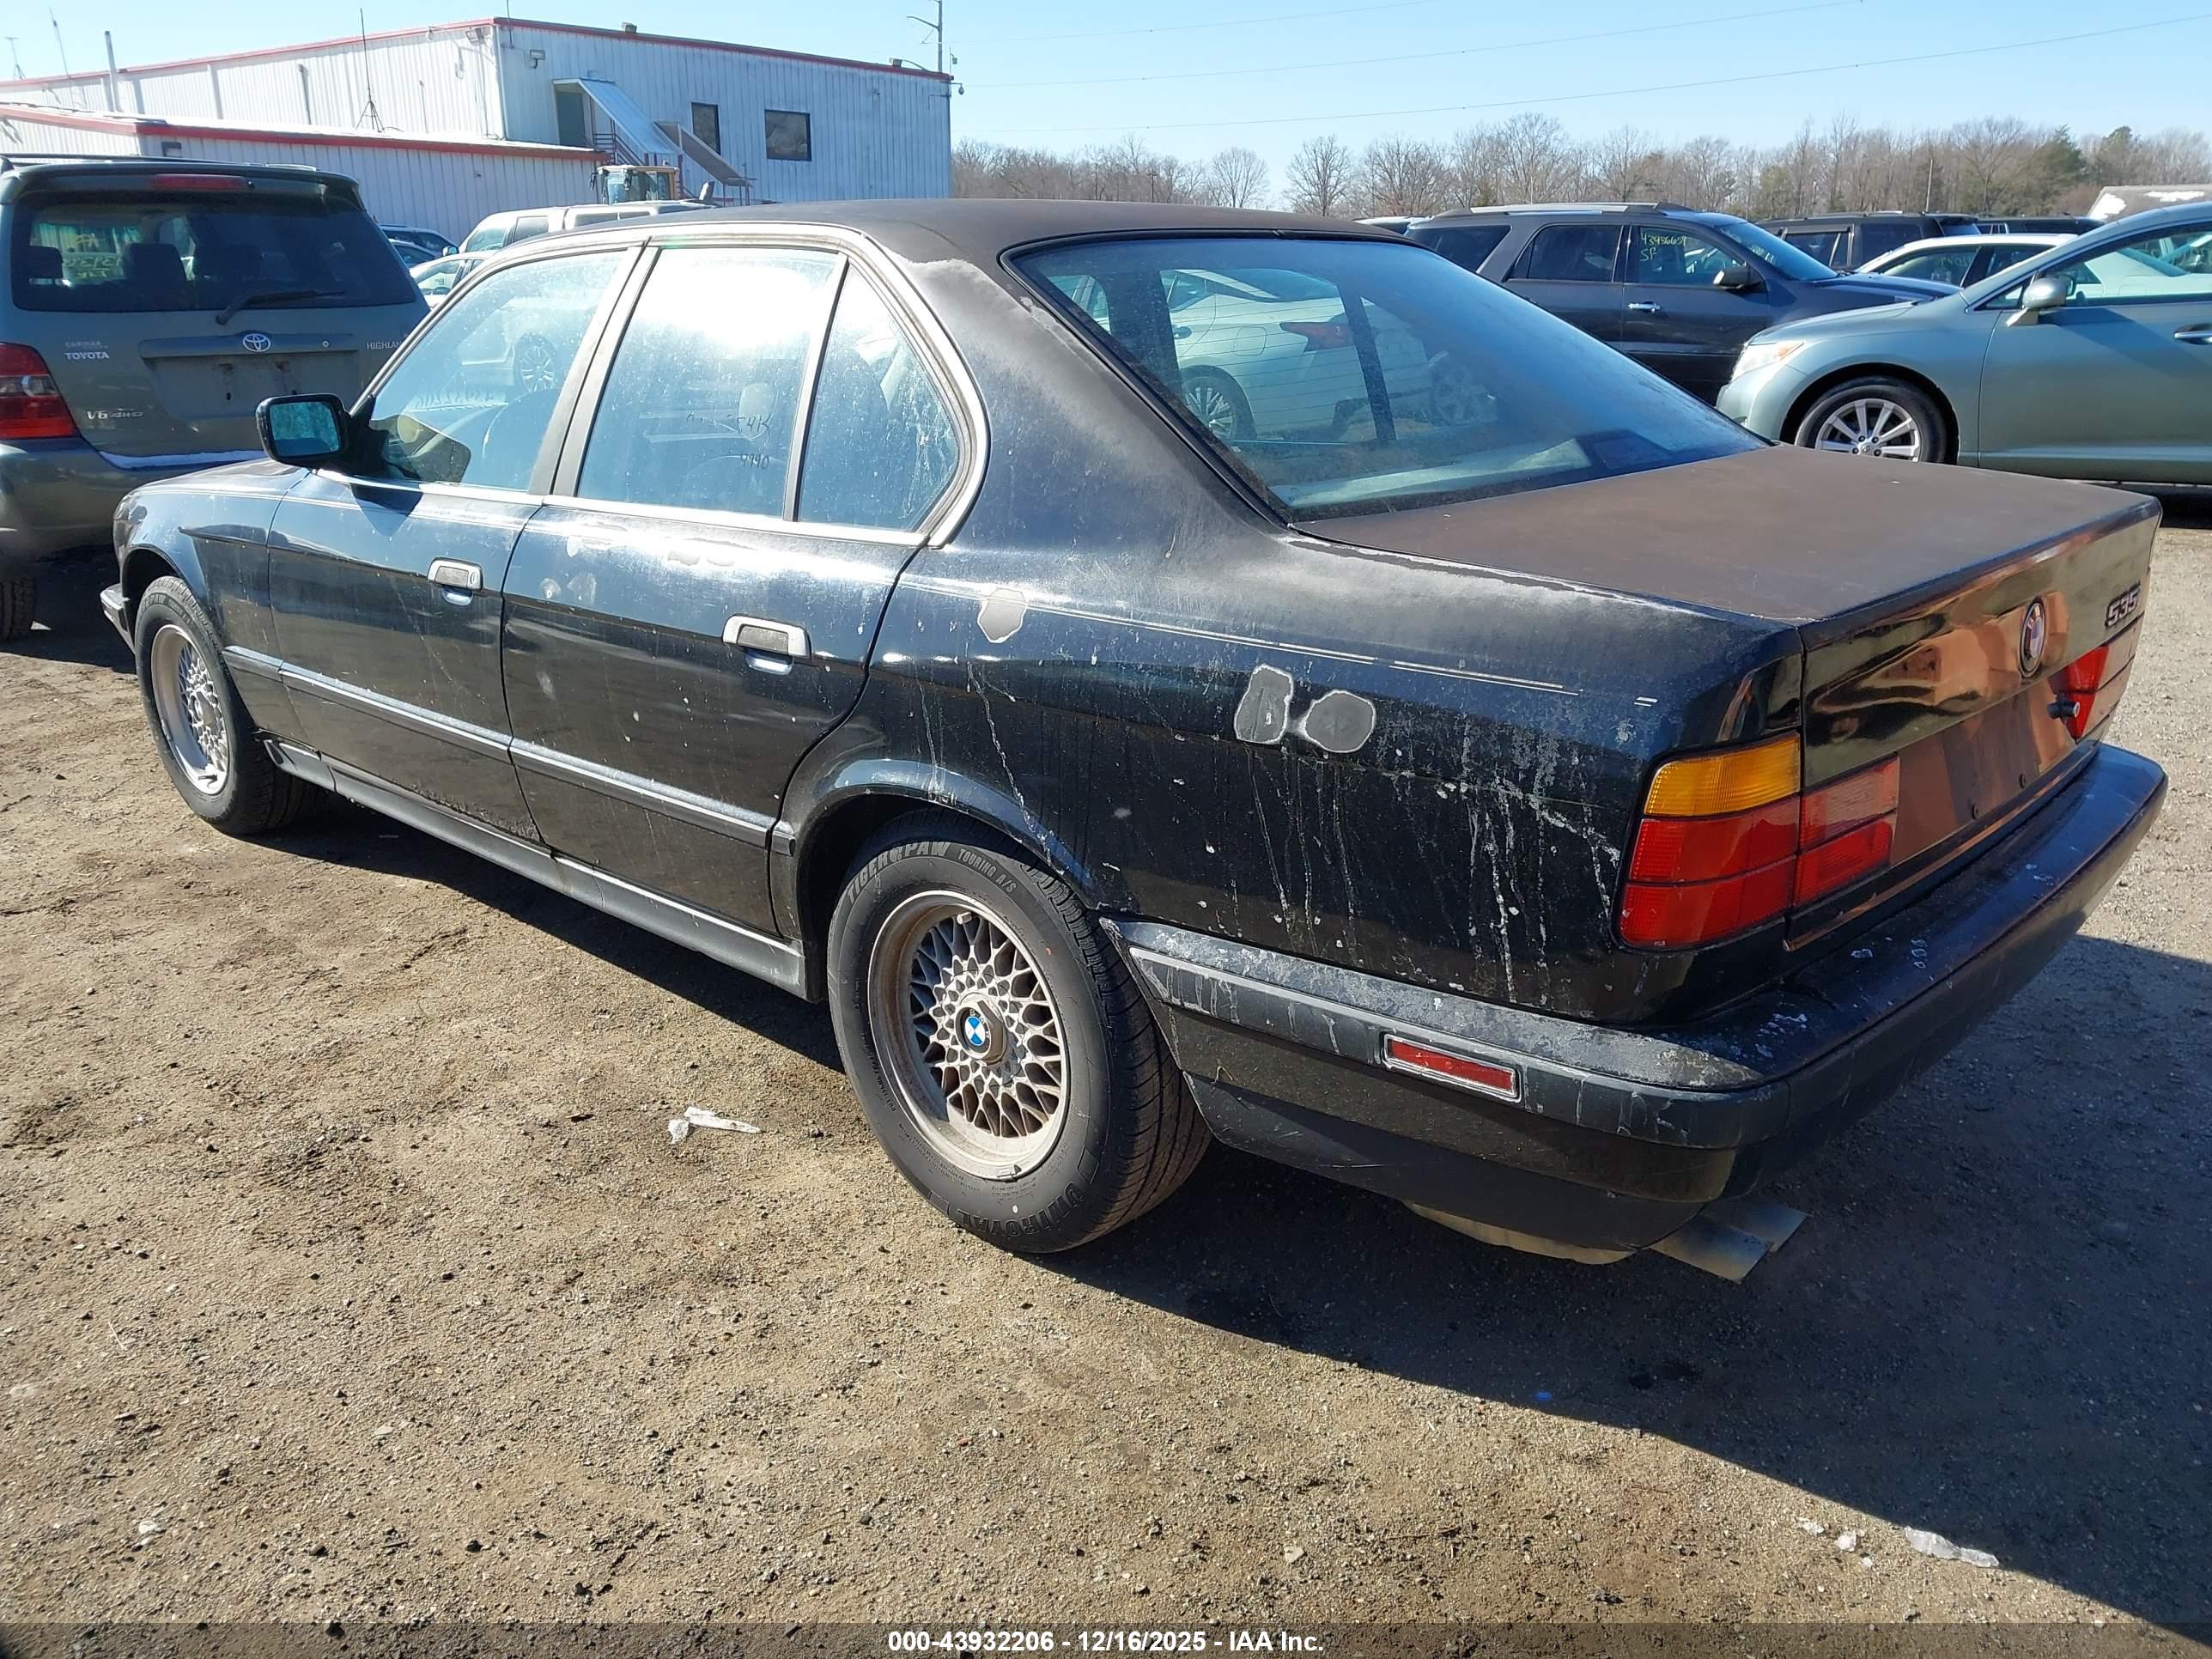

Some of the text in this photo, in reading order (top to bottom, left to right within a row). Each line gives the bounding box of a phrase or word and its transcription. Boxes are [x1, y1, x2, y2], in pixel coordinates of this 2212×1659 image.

[64, 351, 110, 360] TOYOTA
[87, 410, 108, 419] V6
[847, 842, 1017, 905] TIGER PAW TOURING A/S
[957, 1181, 1085, 1237] UNIROYAL
